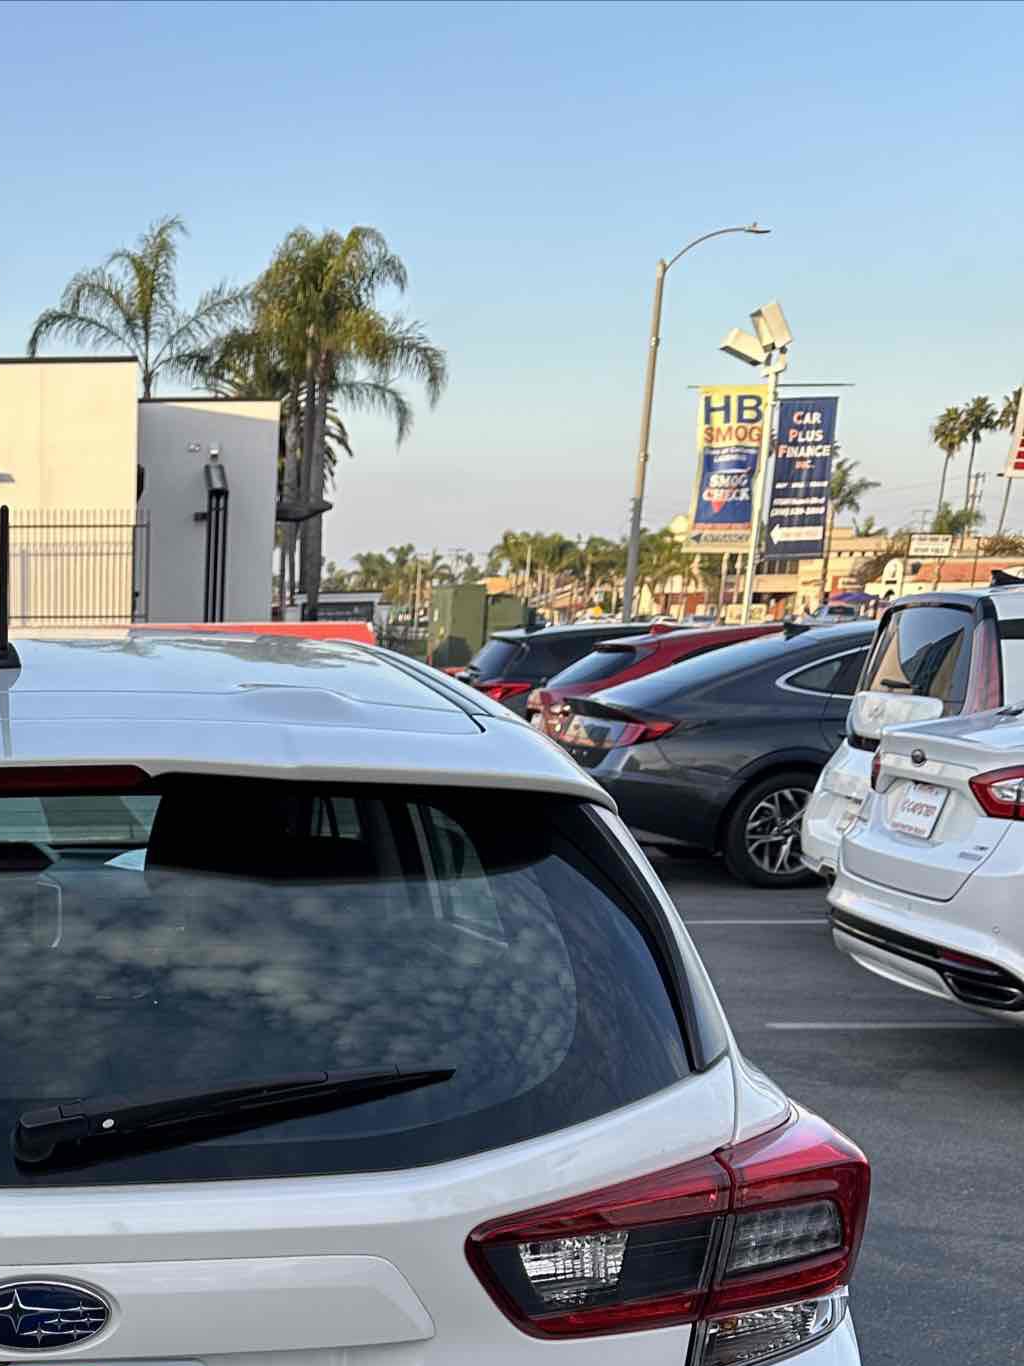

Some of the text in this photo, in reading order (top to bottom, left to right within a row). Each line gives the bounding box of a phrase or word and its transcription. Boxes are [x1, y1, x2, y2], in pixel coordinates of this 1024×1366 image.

[704, 395, 763, 424] HB
[793, 411, 822, 424] CAR
[703, 425, 762, 443] SMOG
[788, 429, 823, 442] PLUS
[778, 445, 831, 458] FINANCE
[709, 474, 748, 487] SMOG
[702, 488, 750, 501] CHECK
